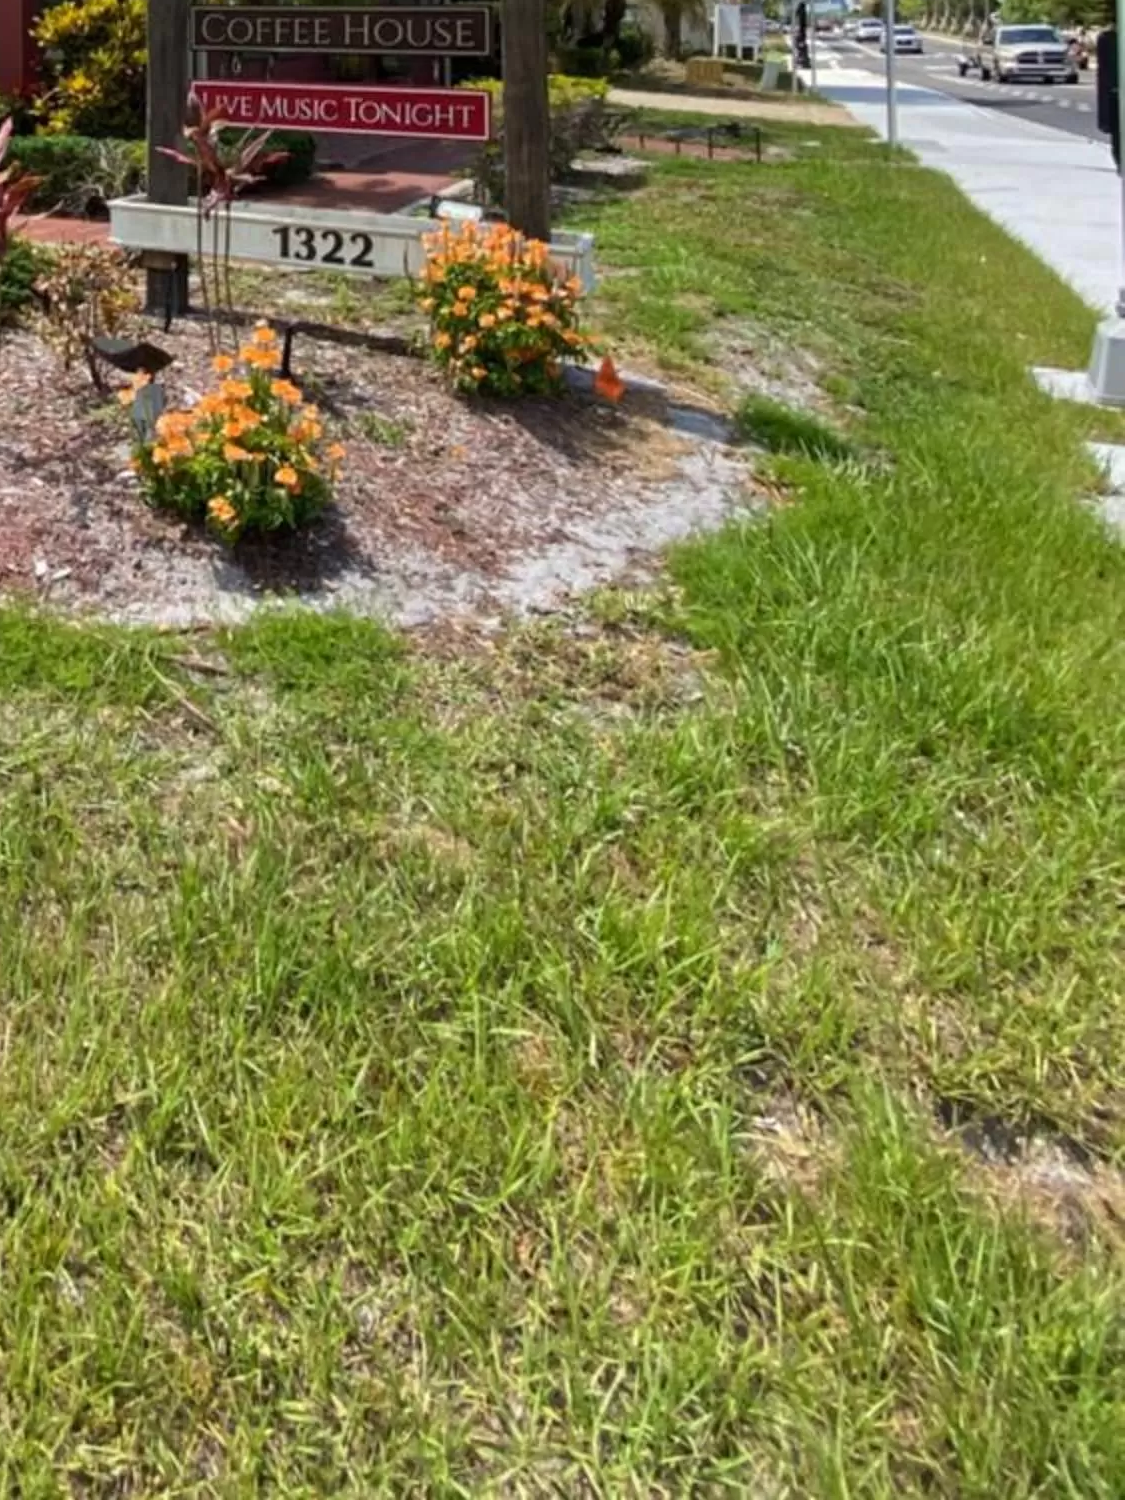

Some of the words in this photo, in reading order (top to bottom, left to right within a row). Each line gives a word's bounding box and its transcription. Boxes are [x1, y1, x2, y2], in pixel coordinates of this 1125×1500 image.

[201, 13, 331, 45] COFFEE
[343, 14, 475, 48] HOUSE
[259, 93, 338, 121] MUSIC
[342, 96, 475, 128] TONIGHT
[272, 226, 374, 268] 1322
